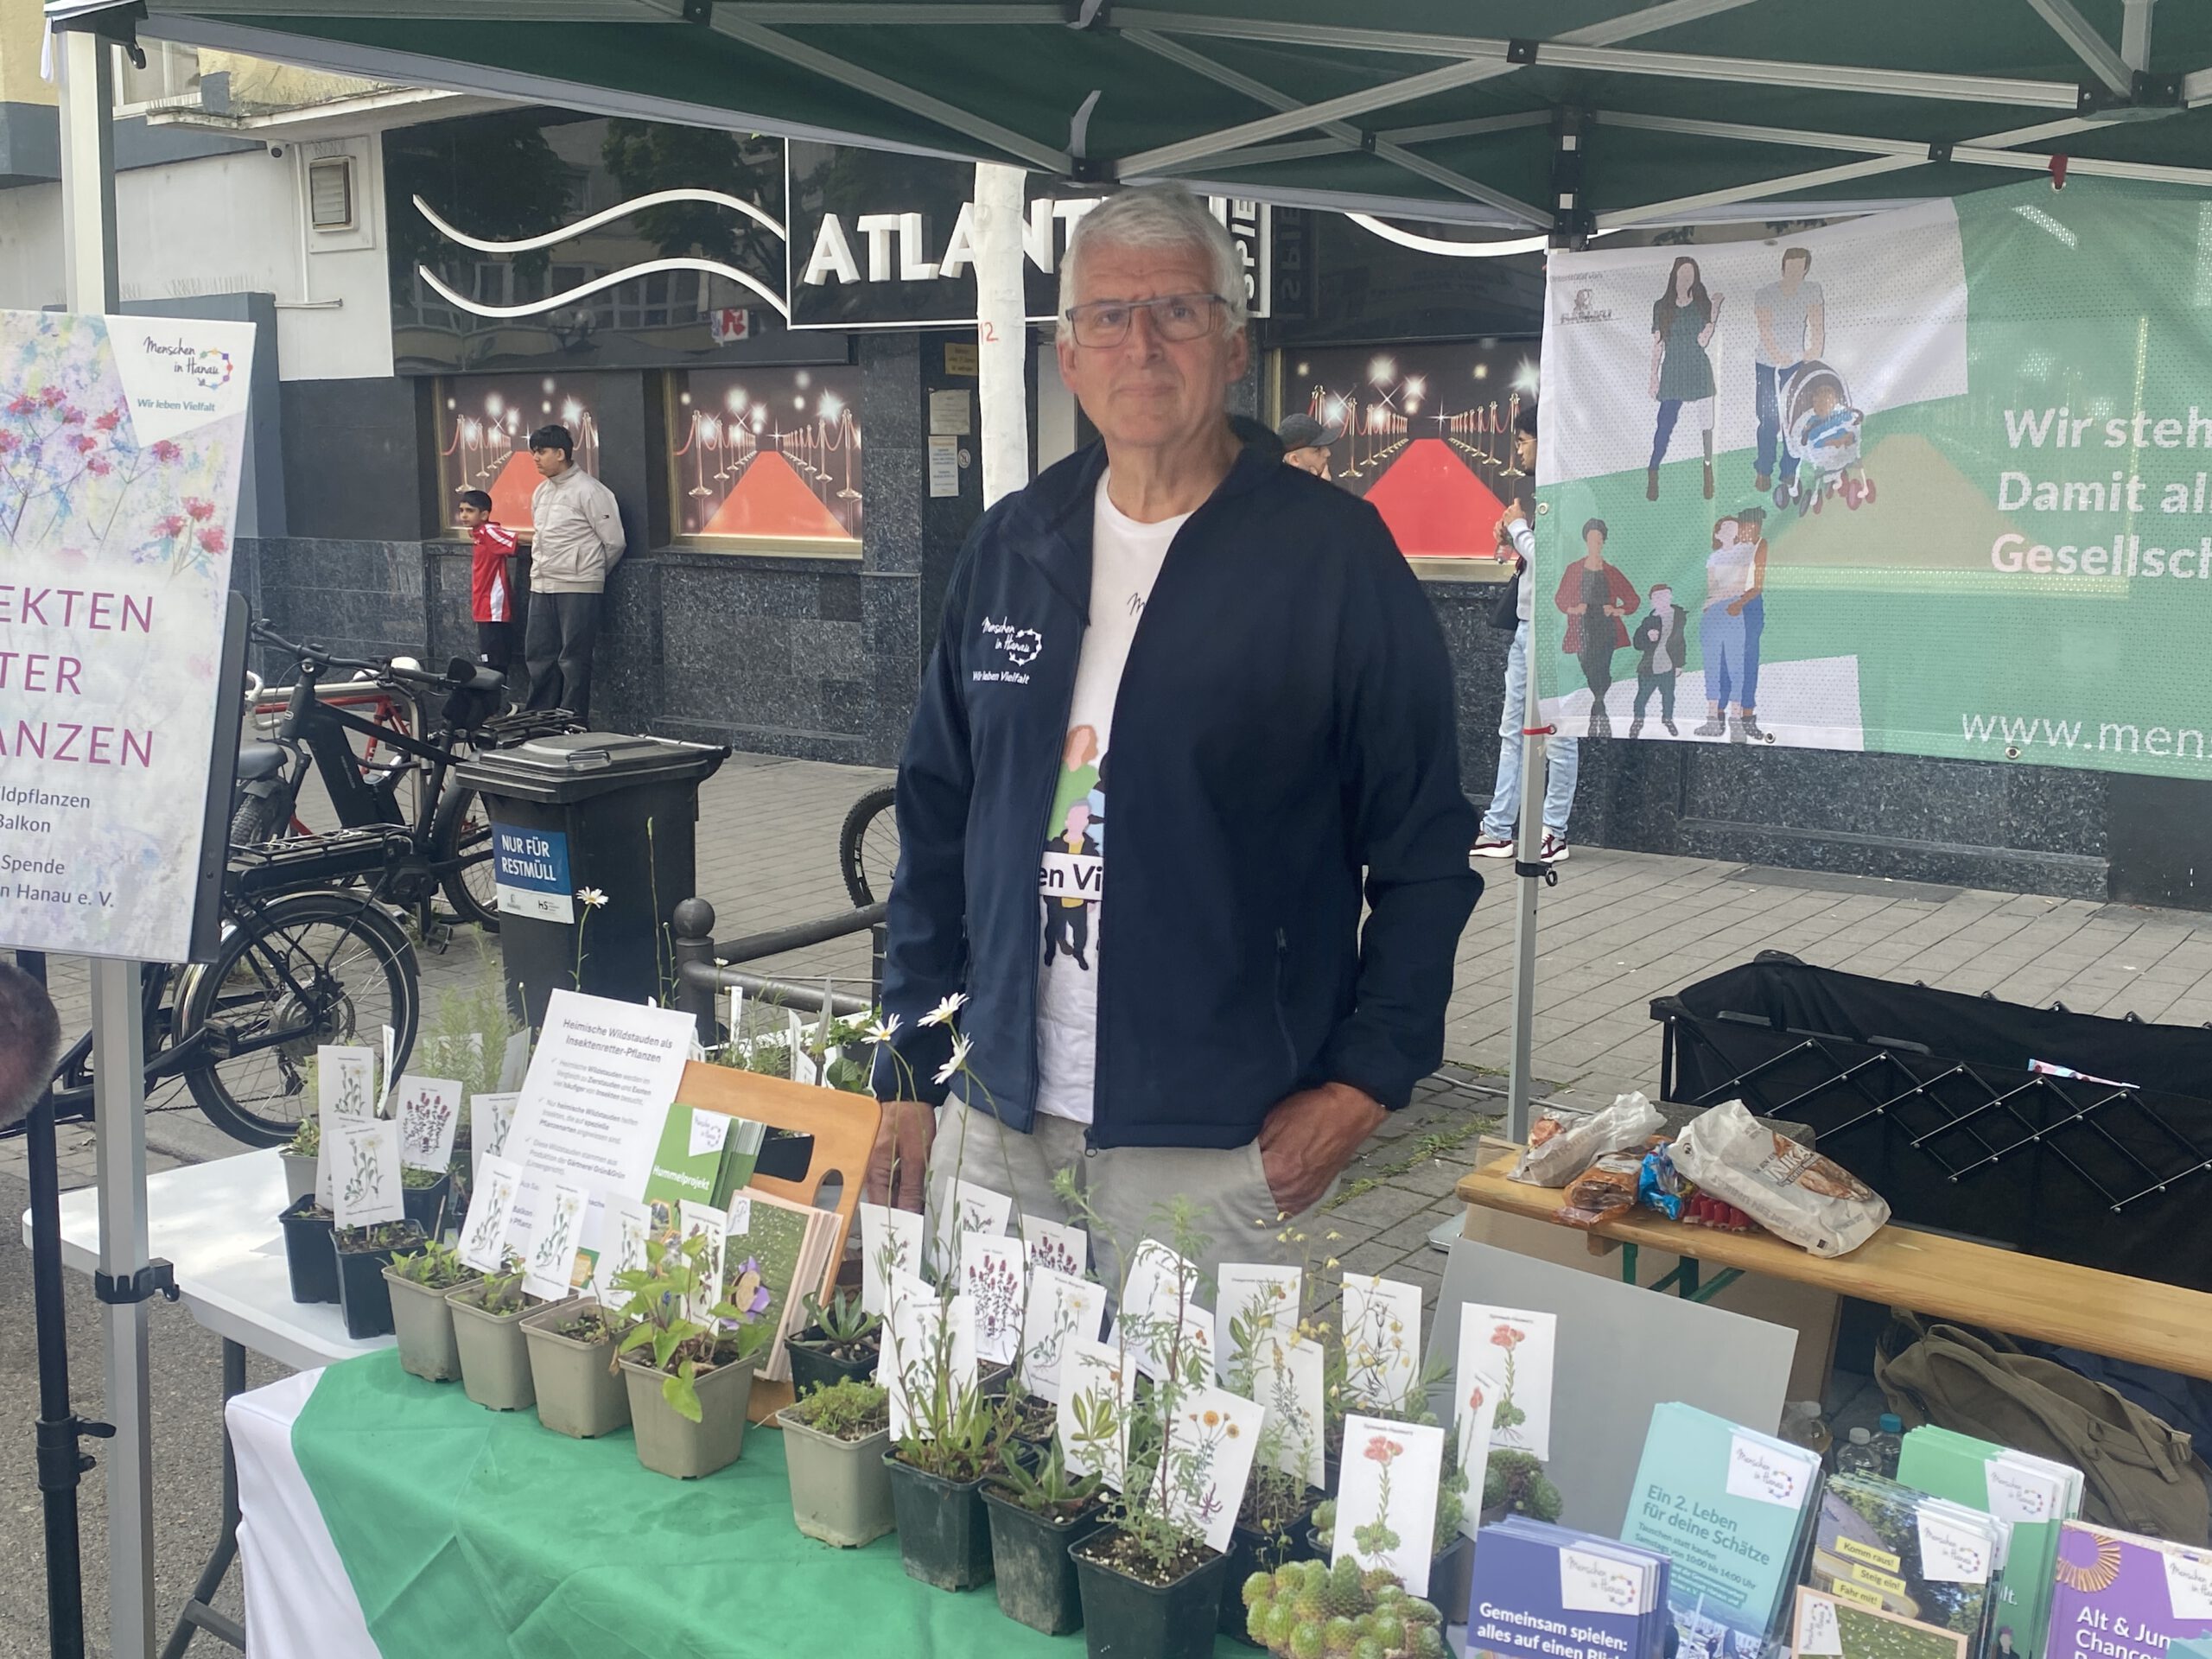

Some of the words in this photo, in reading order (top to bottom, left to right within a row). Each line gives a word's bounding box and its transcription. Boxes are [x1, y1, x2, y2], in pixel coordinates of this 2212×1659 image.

[803, 196, 1109, 286] ATLANT
[143, 335, 195, 356] Menschen
[980, 321, 999, 345] 12
[174, 361, 183, 372] in
[187, 356, 219, 375] Hanau
[137, 398, 155, 408] Wir
[156, 399, 181, 410] leben
[182, 401, 215, 412] Vielfalt
[2004, 406, 2093, 448] Wir
[2104, 406, 2212, 448] steh
[1998, 470, 2146, 513] Damit
[2161, 472, 2212, 513] al
[982, 616, 1015, 634] Menschen
[1004, 633, 1030, 652] Hanau
[0, 652, 82, 695] TER
[982, 671, 1000, 681] leben
[1001, 671, 1030, 684] Vielfalt
[1962, 714, 2212, 760] www.men
[0, 785, 91, 809] ldpflanzen
[501, 835, 524, 854] NUR
[525, 836, 550, 857] FÜR
[3, 854, 66, 875] Spende
[501, 857, 556, 881] RESTMÜLL
[1039, 867, 1064, 888] en
[1073, 863, 1103, 892] Vi
[16, 883, 72, 905] Hanau
[78, 893, 92, 906] e.
[99, 891, 115, 908] V.
[563, 1019, 607, 1036] Heimische
[608, 1027, 659, 1046] Wildstauden
[660, 1038, 673, 1049] als
[565, 1035, 661, 1064] Insektenretter-Pflanzen
[652, 1164, 710, 1191] Hummelprojekt
[1647, 1484, 1671, 1505] Ein
[1675, 1495, 1688, 1512] 2.
[1692, 1503, 1738, 1532] Leben
[1638, 1522, 1672, 1541] Tauschen
[1673, 1534, 1691, 1549] statt
[1691, 1543, 1717, 1560] kaufen
[1643, 1502, 1666, 1521] für
[1668, 1513, 1709, 1540] deine
[1712, 1530, 1770, 1566] Schätze
[1635, 1533, 1669, 1554] Samstags
[1670, 1548, 1685, 1559] von
[1707, 1562, 1719, 1573] bis
[1742, 1577, 1757, 1590] Uhr
[1843, 1541, 1872, 1560] Komm
[1872, 1552, 1895, 1567] raus!
[1840, 1584, 1859, 1599] Fahr
[1859, 1591, 1878, 1605] mit!
[1860, 1569, 1882, 1586] Steig
[1883, 1578, 1901, 1592] ein!
[1479, 1602, 1567, 1637] Gemeinsam
[1570, 1626, 1628, 1652] spielen:
[2076, 1606, 2109, 1630] Alt
[2113, 1617, 2130, 1638] &
[2134, 1624, 2171, 1650] Jun
[1477, 1624, 1511, 1643] alles
[1514, 1633, 1540, 1649] auf
[1541, 1639, 1583, 1659] einen
[2075, 1629, 2162, 1659] Chance
